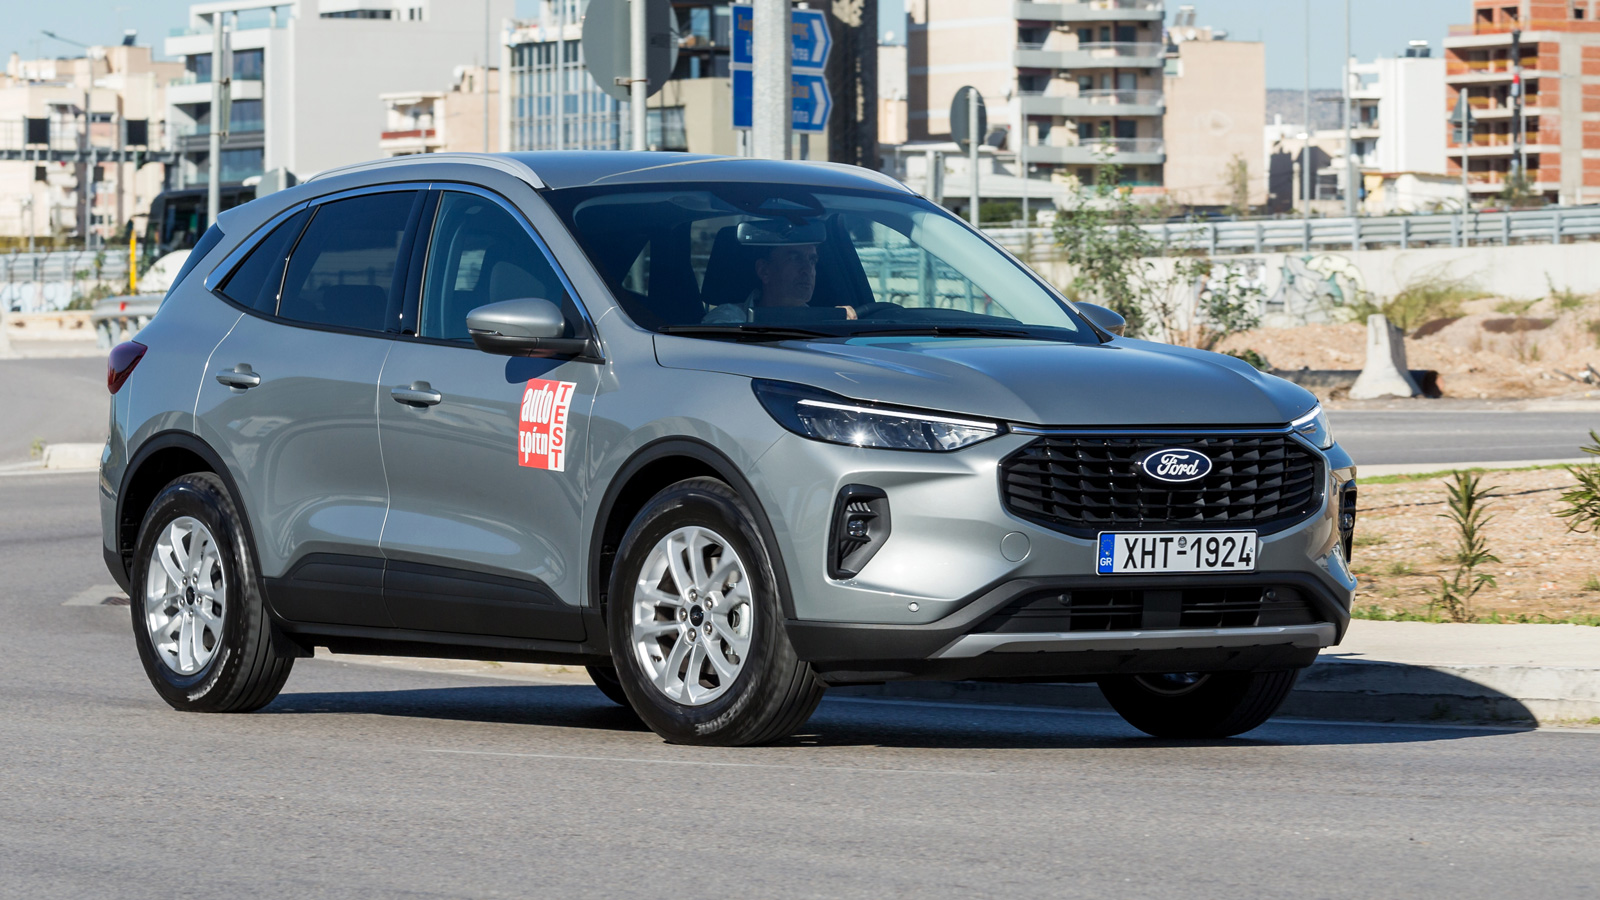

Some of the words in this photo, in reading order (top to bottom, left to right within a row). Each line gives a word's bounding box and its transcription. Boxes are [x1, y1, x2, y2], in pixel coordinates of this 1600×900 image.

[551, 384, 573, 468] TEST
[1156, 453, 1200, 476] Ford
[1099, 557, 1112, 567] GR
